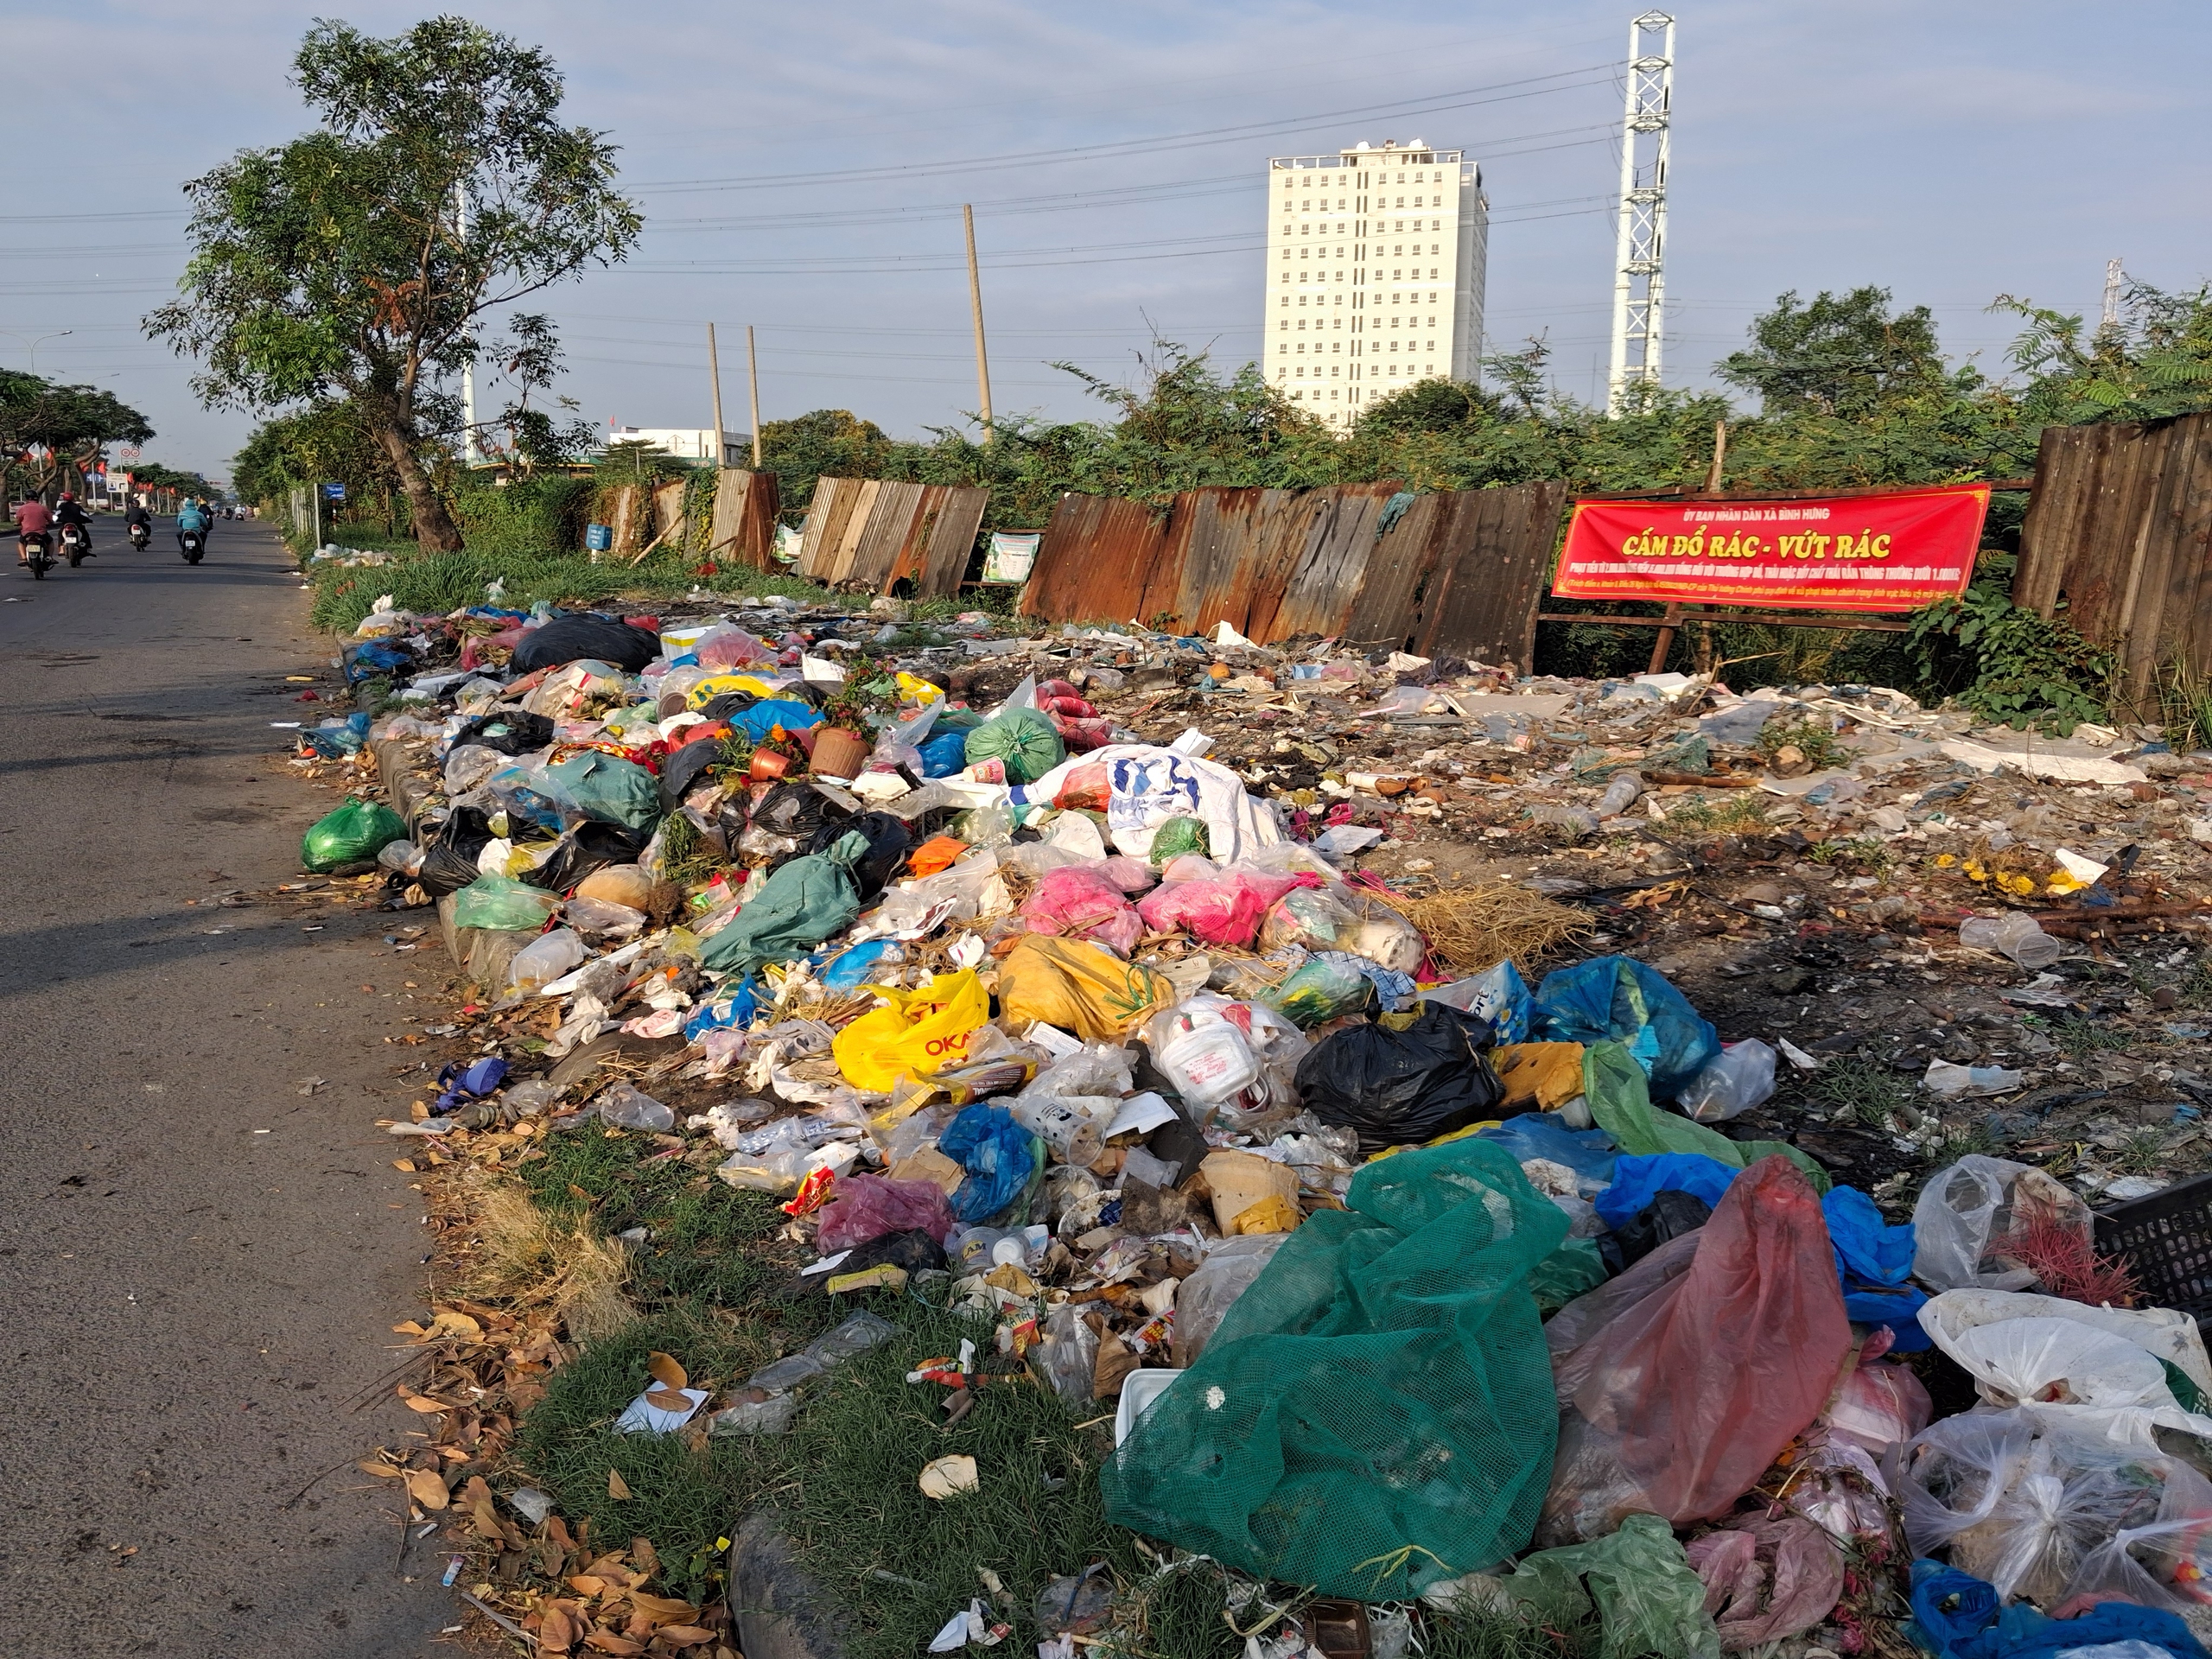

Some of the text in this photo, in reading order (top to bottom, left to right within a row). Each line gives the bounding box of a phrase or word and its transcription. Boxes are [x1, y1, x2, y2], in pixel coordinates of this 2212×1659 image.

[1695, 511, 1714, 521] BAN
[1714, 508, 1741, 521] NHÂN
[1742, 507, 1762, 521] DÂN
[1778, 506, 1802, 520] BÌNH
[1802, 507, 1830, 520] HƯNG
[1622, 526, 1669, 556] CẤM
[1670, 524, 1707, 556] ĐỔ
[1708, 530, 1760, 557] RÁC
[1778, 529, 1830, 558] VỨT
[1834, 528, 1891, 558] RÁC
[1471, 990, 1489, 1015] ort
